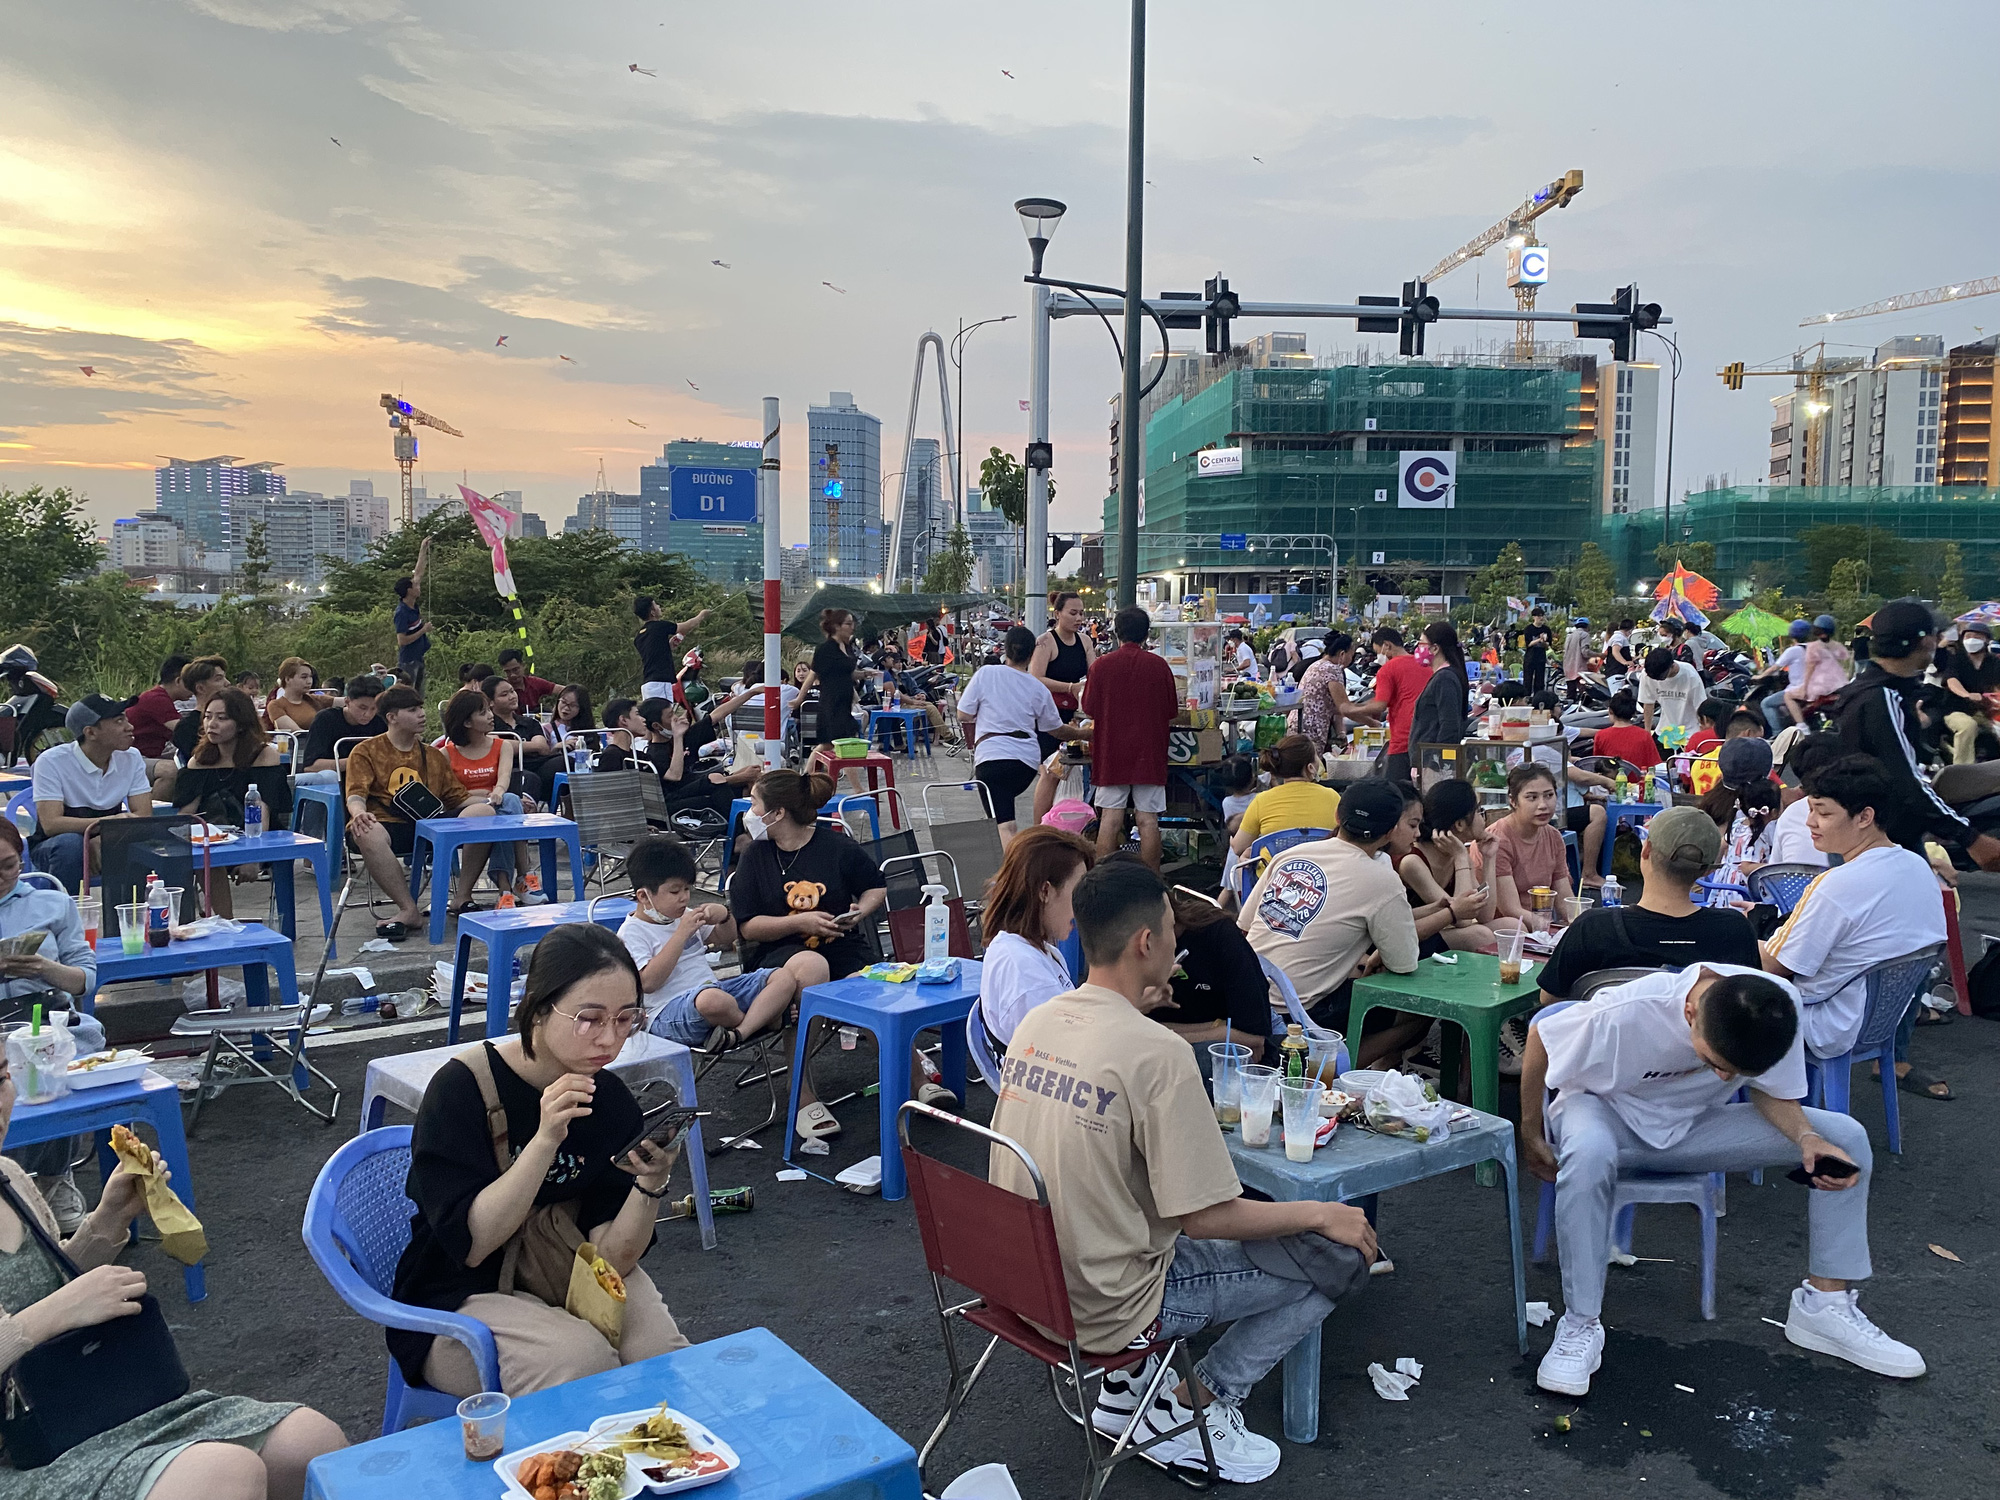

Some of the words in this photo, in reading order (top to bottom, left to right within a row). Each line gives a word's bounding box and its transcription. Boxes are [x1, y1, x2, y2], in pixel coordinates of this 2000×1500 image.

[1368, 420, 1373, 428] 6
[1211, 456, 1240, 464] CENTRAL
[692, 472, 733, 485] ĐƯỜNG
[1378, 491, 1383, 500] 4
[700, 495, 725, 512] D1
[1376, 554, 1381, 562] 2
[463, 767, 494, 775] Feeling
[1286, 863, 1323, 888] WESTLEAGUE
[1299, 909, 1310, 920] 78
[1035, 1049, 1050, 1060] BASE
[1055, 1056, 1077, 1069] VietNam
[1002, 1057, 1117, 1116] ERGENCY
